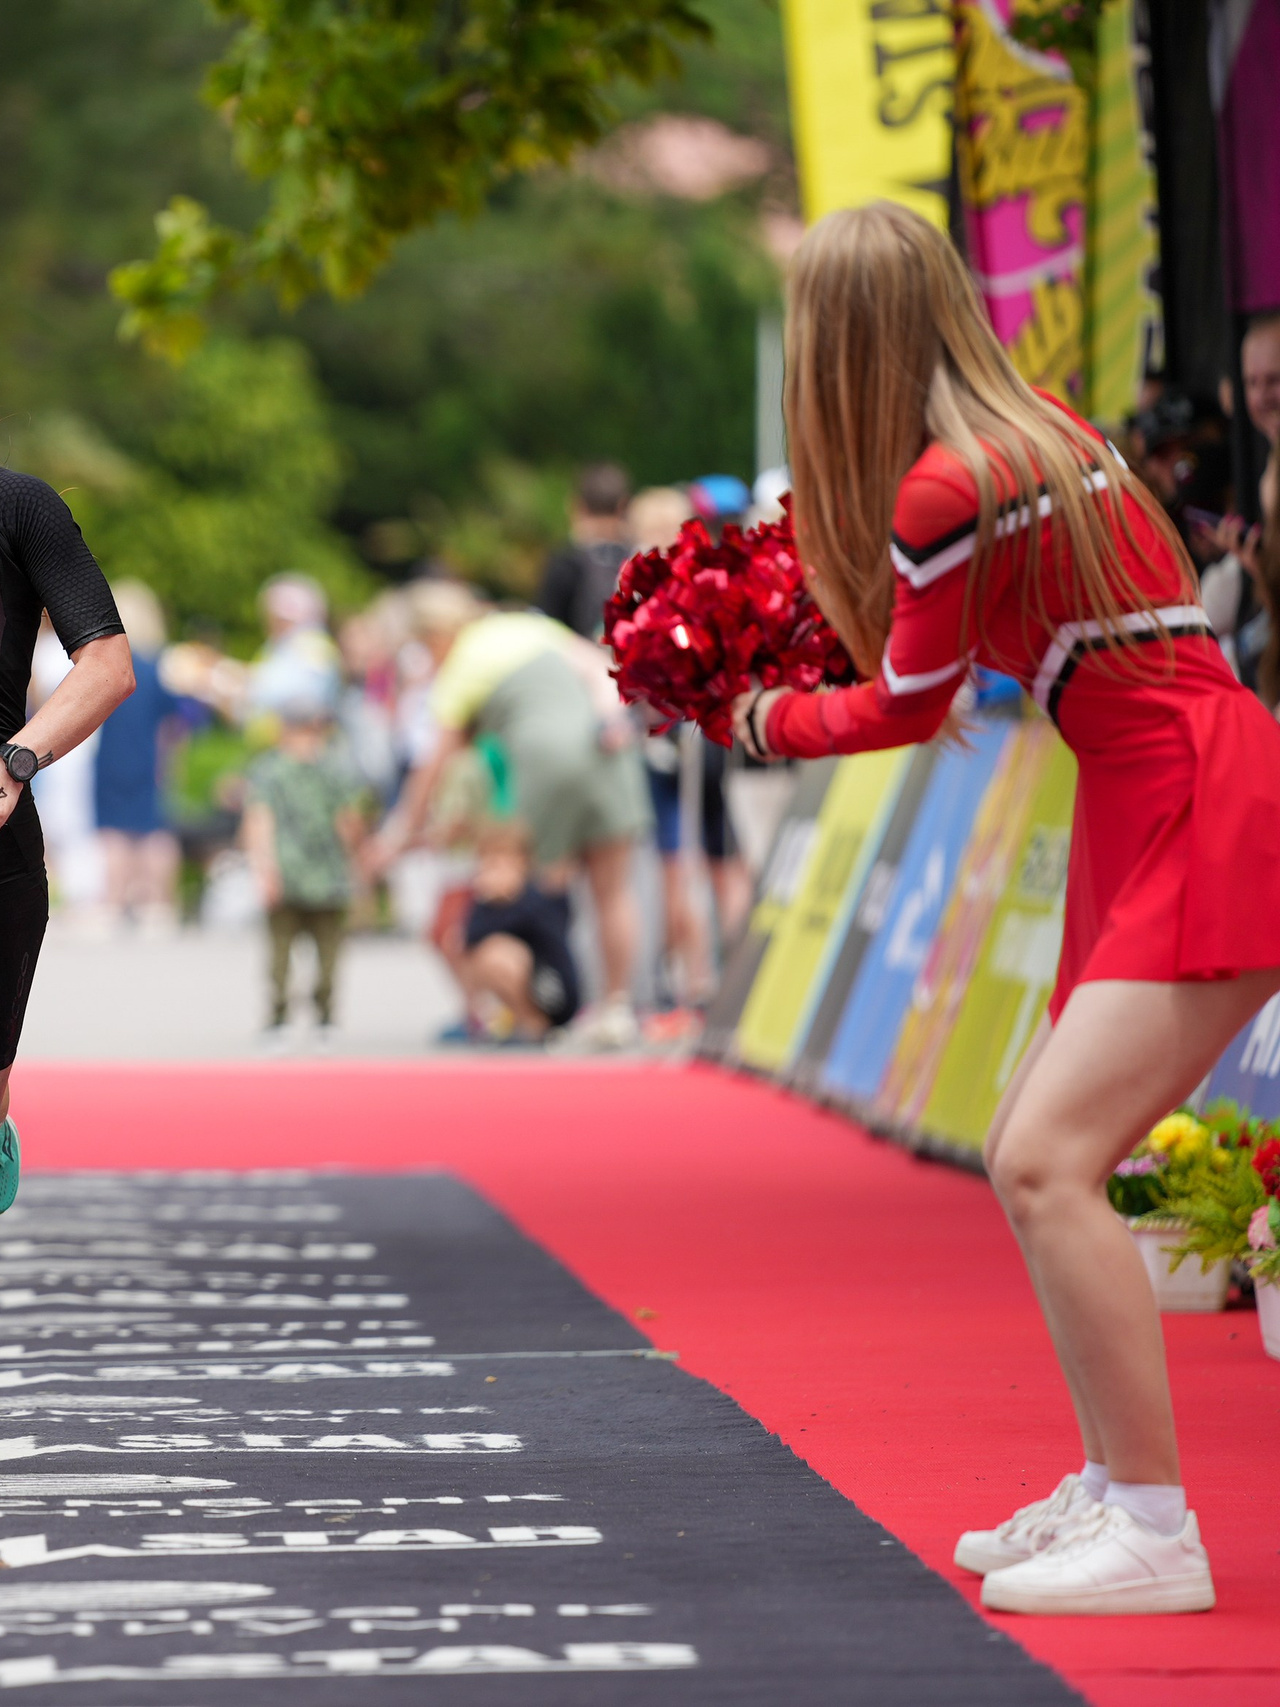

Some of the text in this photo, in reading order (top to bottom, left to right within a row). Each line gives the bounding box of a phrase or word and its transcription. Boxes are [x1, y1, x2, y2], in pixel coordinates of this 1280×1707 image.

[116, 1432, 523, 1449] STAR
[140, 1525, 601, 1549] STAR
[163, 1642, 696, 1675] STAR
